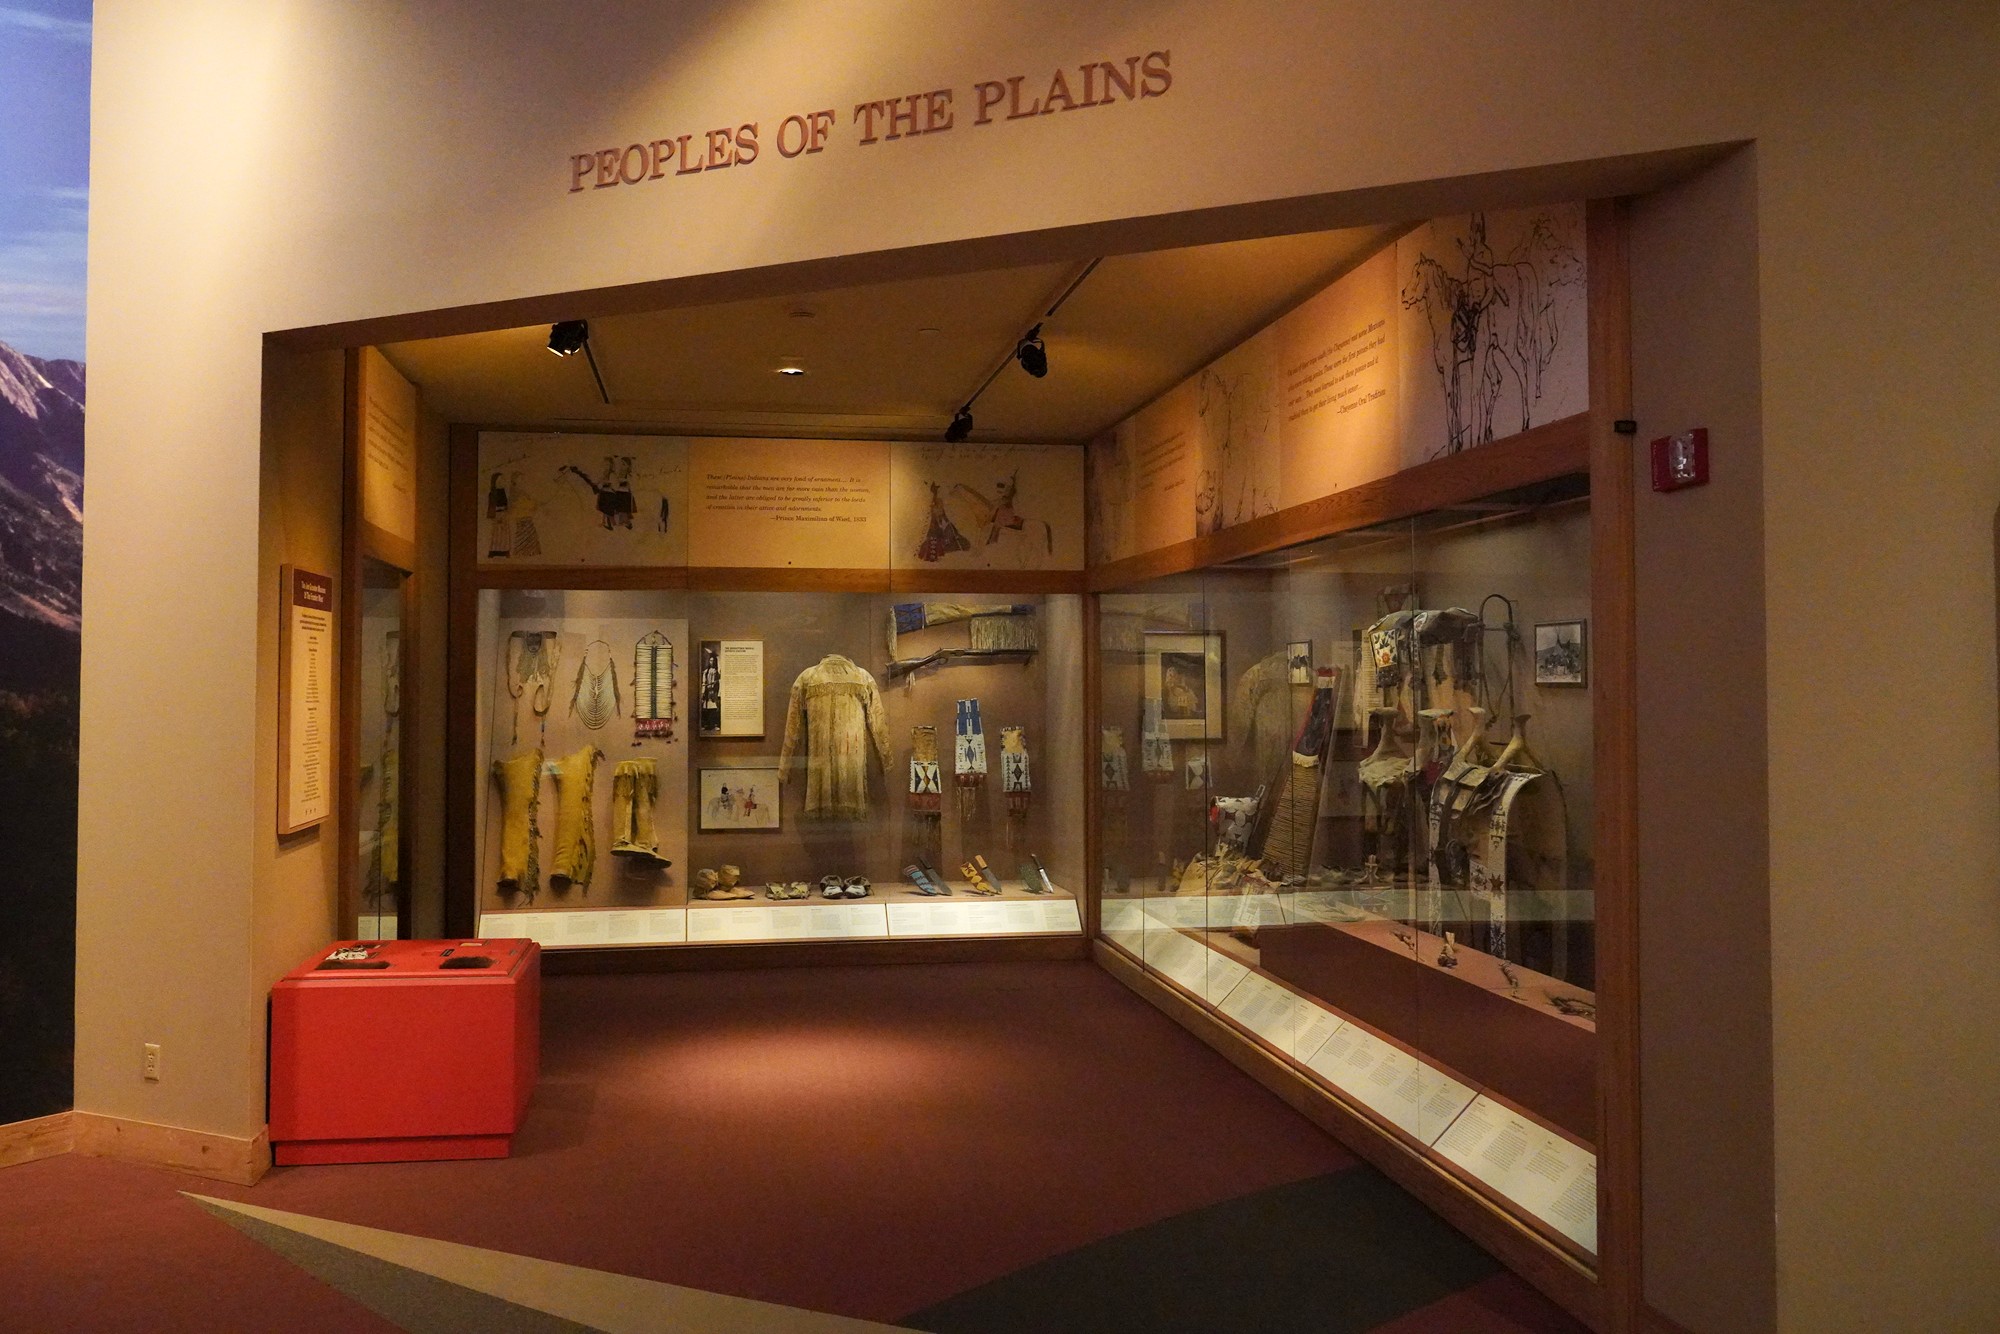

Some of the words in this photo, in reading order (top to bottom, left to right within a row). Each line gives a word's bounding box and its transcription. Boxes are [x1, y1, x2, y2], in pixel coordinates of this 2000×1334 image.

[568, 121, 760, 194] PEOPLES
[776, 109, 835, 158] OF
[854, 88, 954, 146] THE
[974, 49, 1173, 126] PLAINS
